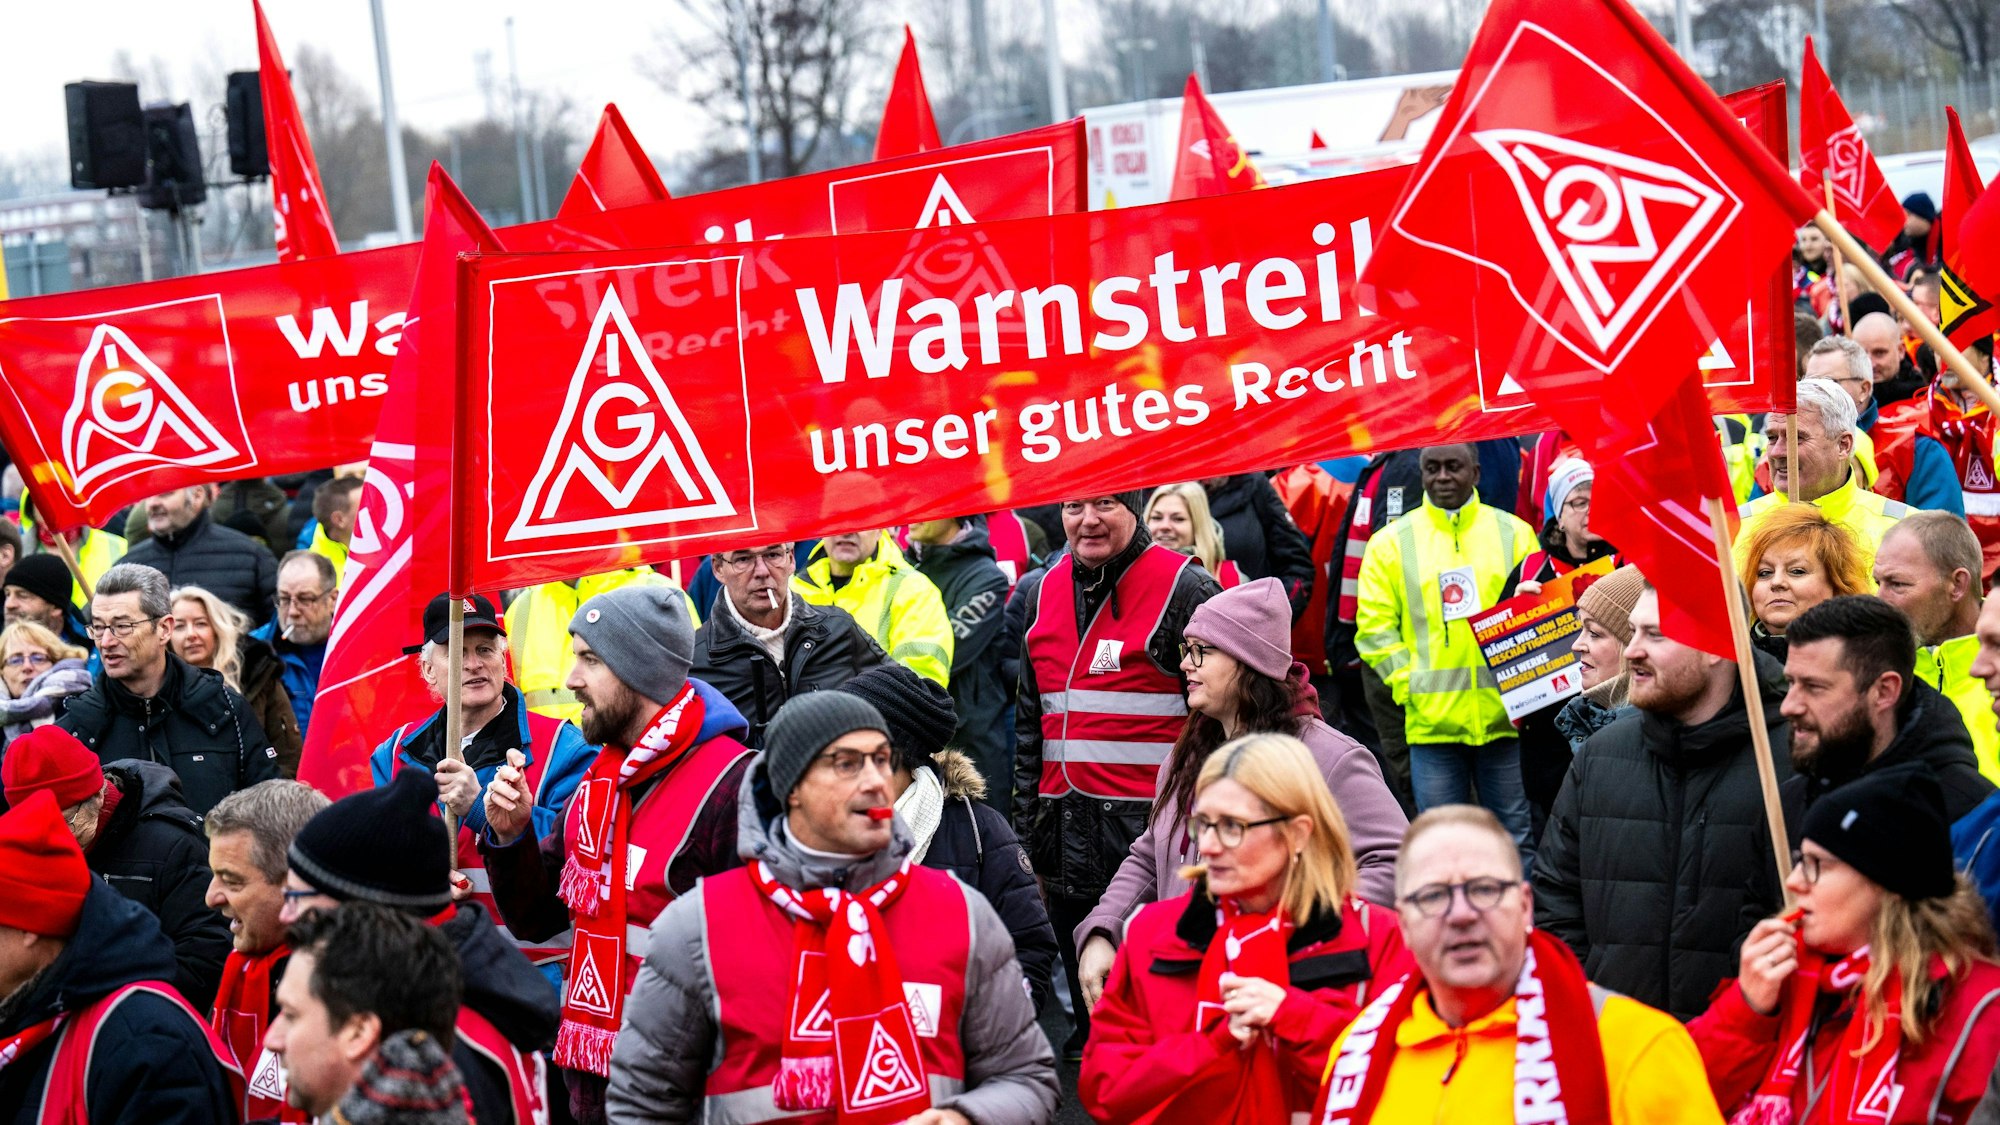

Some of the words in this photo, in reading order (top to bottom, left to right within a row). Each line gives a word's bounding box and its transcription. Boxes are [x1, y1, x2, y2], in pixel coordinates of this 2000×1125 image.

[275, 299, 407, 359] Wa
[287, 372, 389, 413] uns
[808, 409, 998, 475] unser
[1018, 381, 1210, 463] gutes
[1231, 329, 1418, 411] Recht
[1472, 608, 1514, 633] ZUKUNFT
[1477, 626, 1505, 642] STATT
[1504, 597, 1565, 630] KAHLSCHLAG!
[1484, 637, 1515, 659] HÄNDE
[1515, 629, 1537, 645] WEG
[1535, 619, 1557, 635] VON
[1556, 612, 1575, 627] DER
[1488, 619, 1583, 668] BESCHÄFTIGUNGSSICH
[1535, 652, 1576, 677] BLEIBEN!
[1496, 665, 1520, 683] ALLE
[1516, 652, 1550, 673] WERKE
